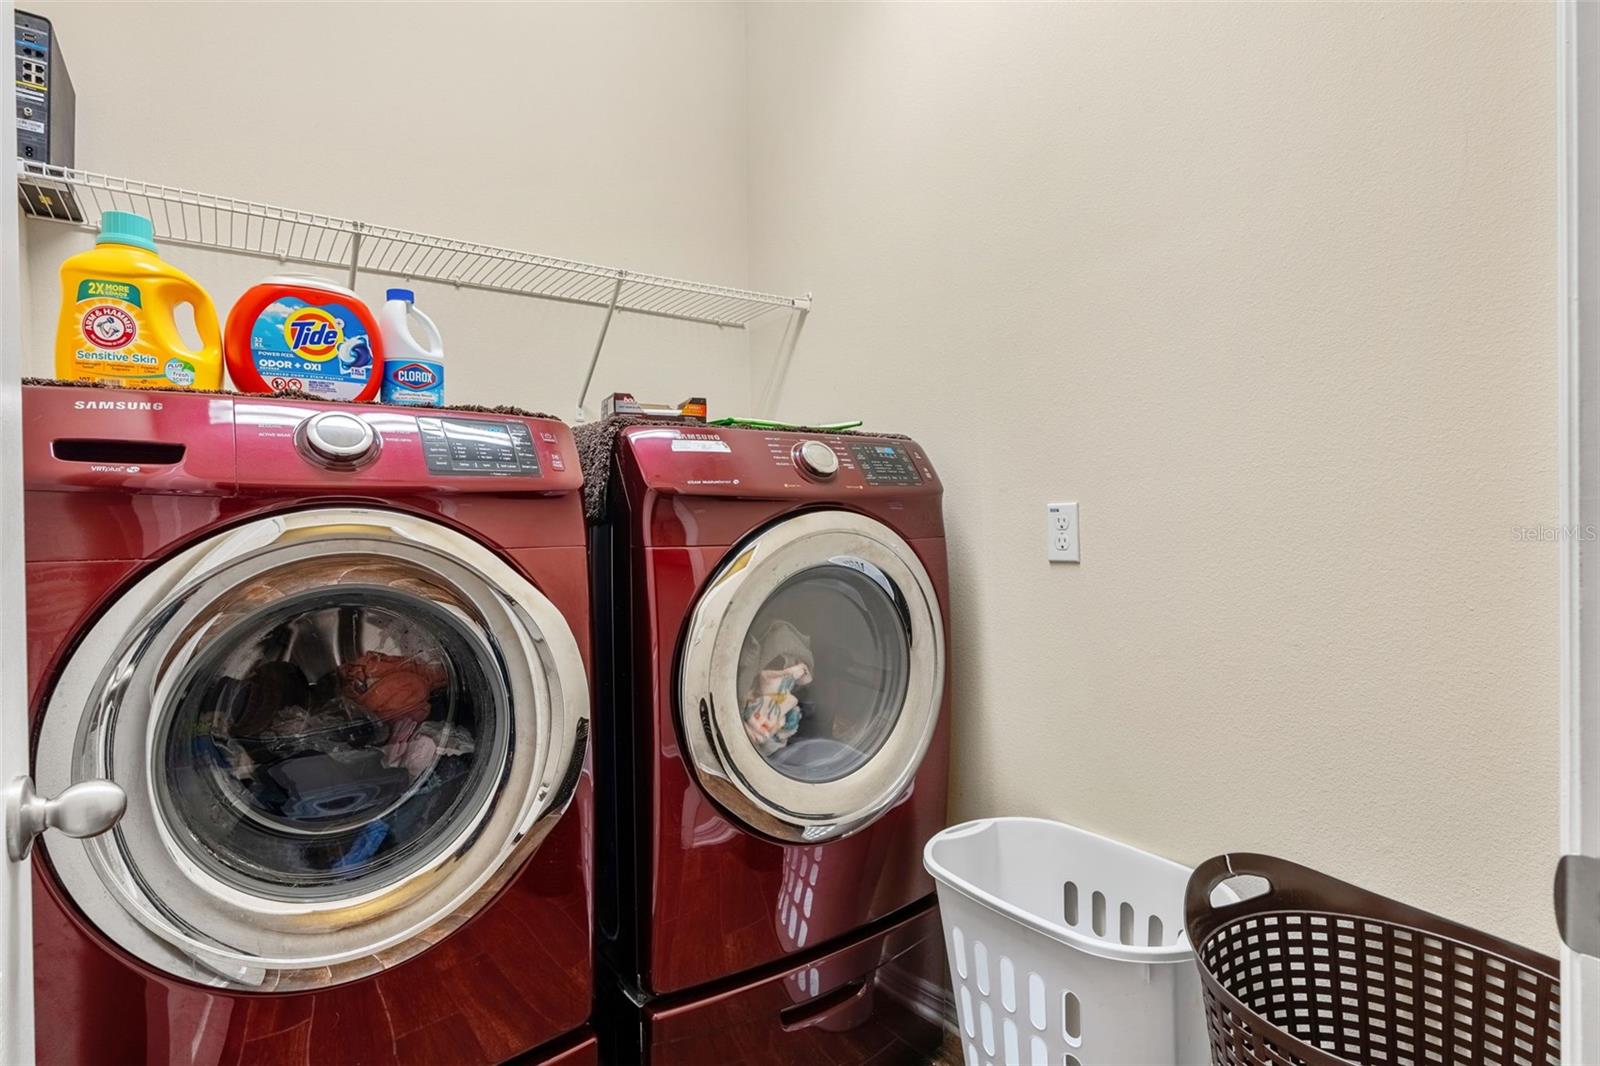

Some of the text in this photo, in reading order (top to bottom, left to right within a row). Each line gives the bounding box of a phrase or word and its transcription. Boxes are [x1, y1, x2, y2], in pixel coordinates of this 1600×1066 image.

[88, 282, 104, 295] 2X
[105, 283, 130, 293] MORE
[85, 313, 98, 331] ARM
[103, 308, 133, 333] HAMMER
[290, 321, 338, 350] Tide
[77, 350, 157, 364] Sensitive Skin
[259, 359, 292, 369] ODOR
[303, 362, 322, 372] OXI
[398, 370, 433, 383] CLOROX
[74, 400, 164, 410] SAMSUNG
